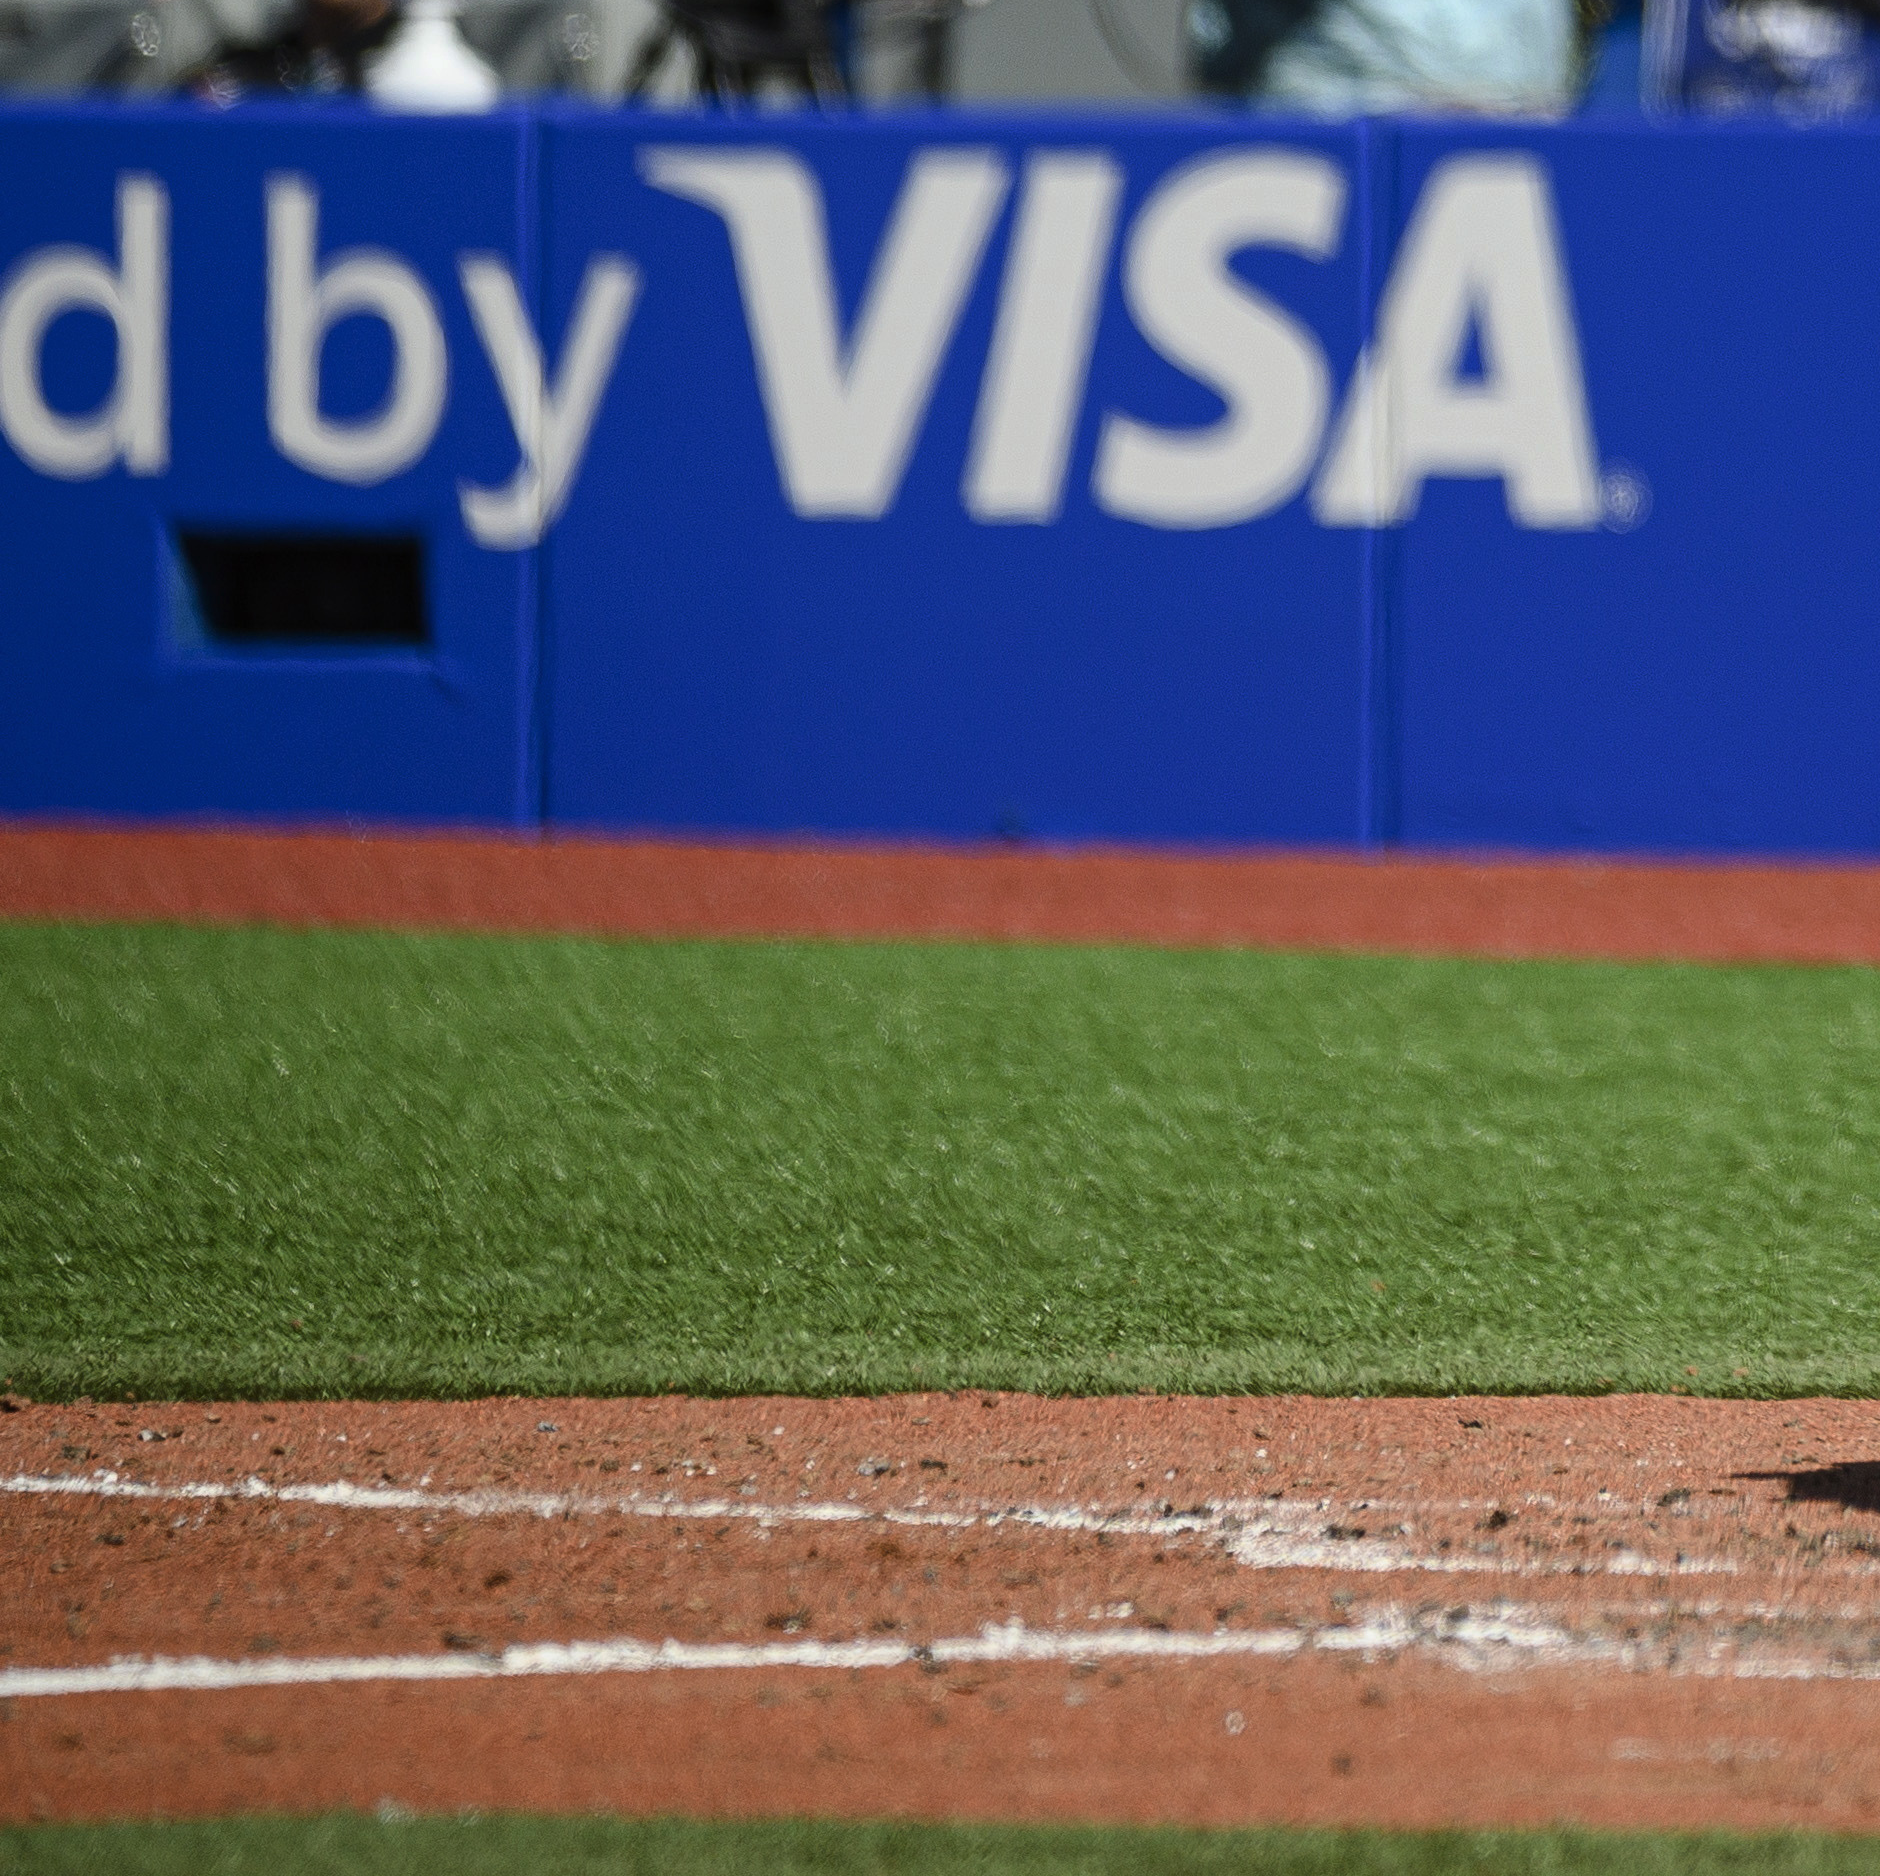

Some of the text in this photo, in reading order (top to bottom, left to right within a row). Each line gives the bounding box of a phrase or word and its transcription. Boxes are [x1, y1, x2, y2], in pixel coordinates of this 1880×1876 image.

[0, 144, 1603, 551] d by VISA
